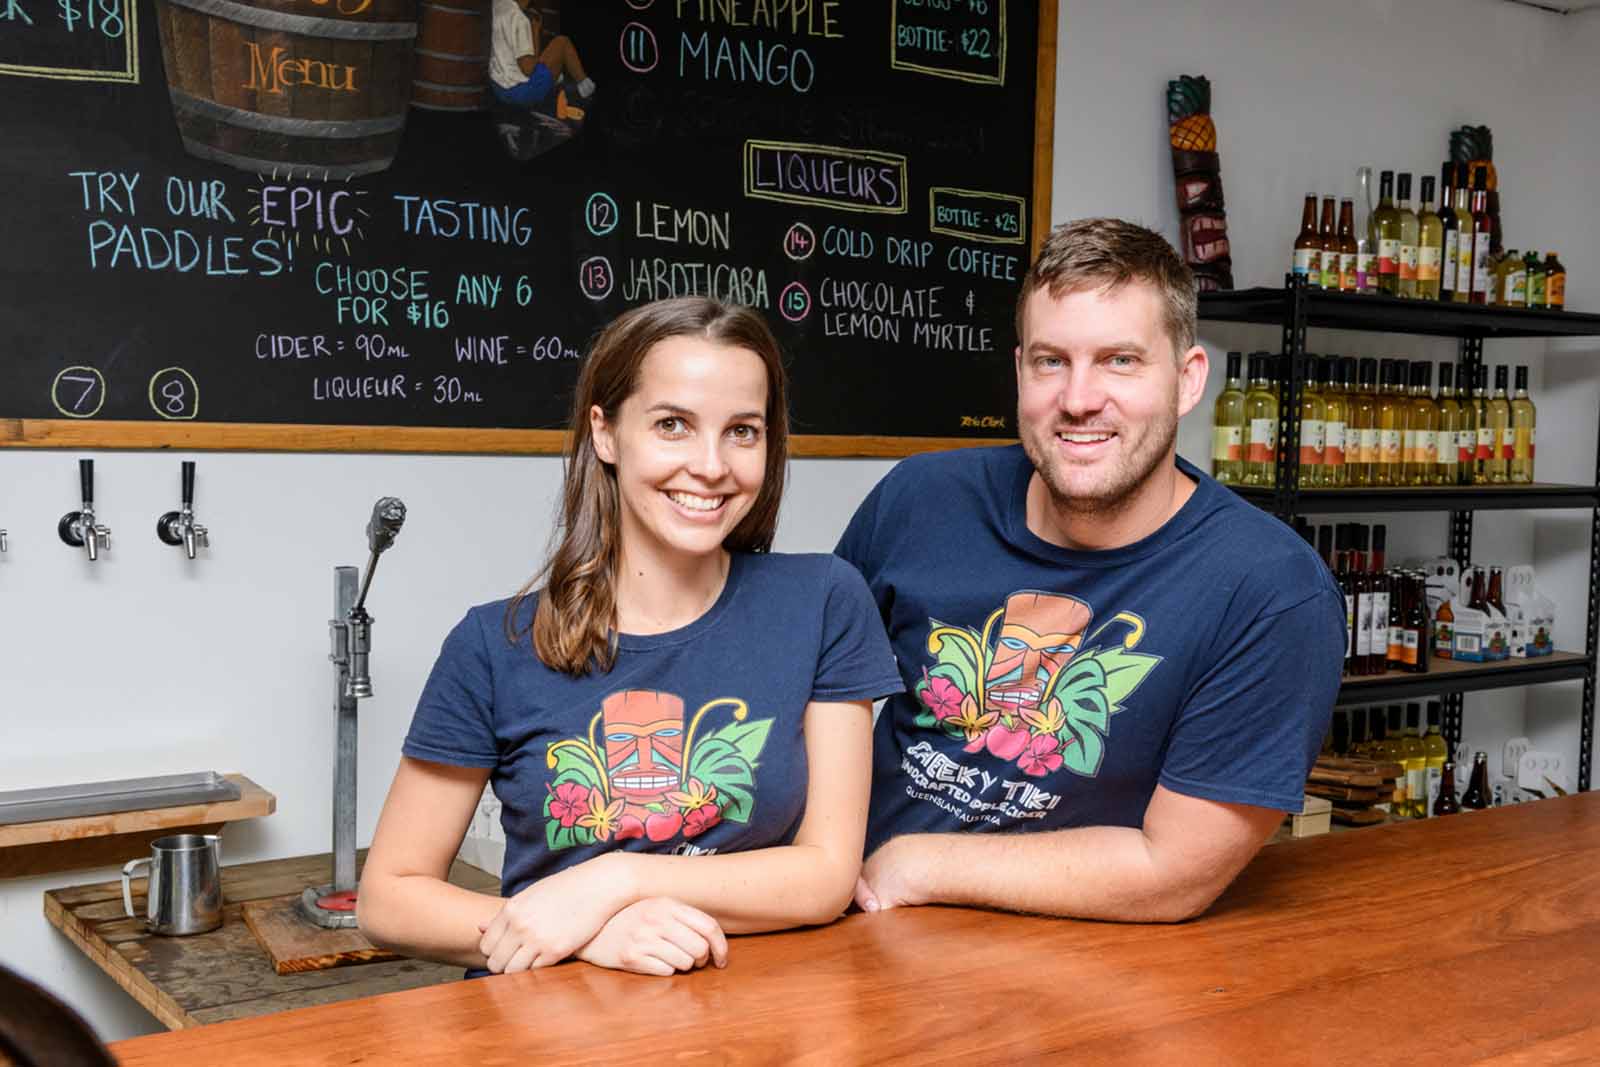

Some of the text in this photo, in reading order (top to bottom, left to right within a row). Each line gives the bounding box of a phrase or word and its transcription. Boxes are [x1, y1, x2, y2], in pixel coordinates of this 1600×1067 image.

[58, 0, 123, 37] $18
[680, 31, 815, 93] MANGO
[961, 28, 992, 58] $22
[241, 41, 359, 93] Menu
[756, 151, 898, 206] LIQUEURS
[68, 172, 532, 246] TRY OUR EPIC TASTING
[636, 200, 730, 250] LEMON
[995, 212, 1018, 233] $25
[89, 219, 294, 276] PADDLES!
[823, 225, 874, 259] COLD
[887, 236, 934, 268] DRIP
[947, 245, 1018, 281] COFFEE
[315, 262, 533, 308] CHOOSE ANY 6
[622, 257, 770, 310] JABOTICABA
[820, 277, 945, 319] CHOCOLATE
[337, 297, 449, 328] FOR $16
[824, 312, 993, 352] LEMON MYRTLE
[255, 334, 332, 359] CIDER
[455, 335, 509, 364] WINE
[61, 375, 96, 410] 7
[162, 379, 185, 412] 8
[313, 374, 407, 400] LIQUEUR
[1001, 779, 1061, 810] TIKI
